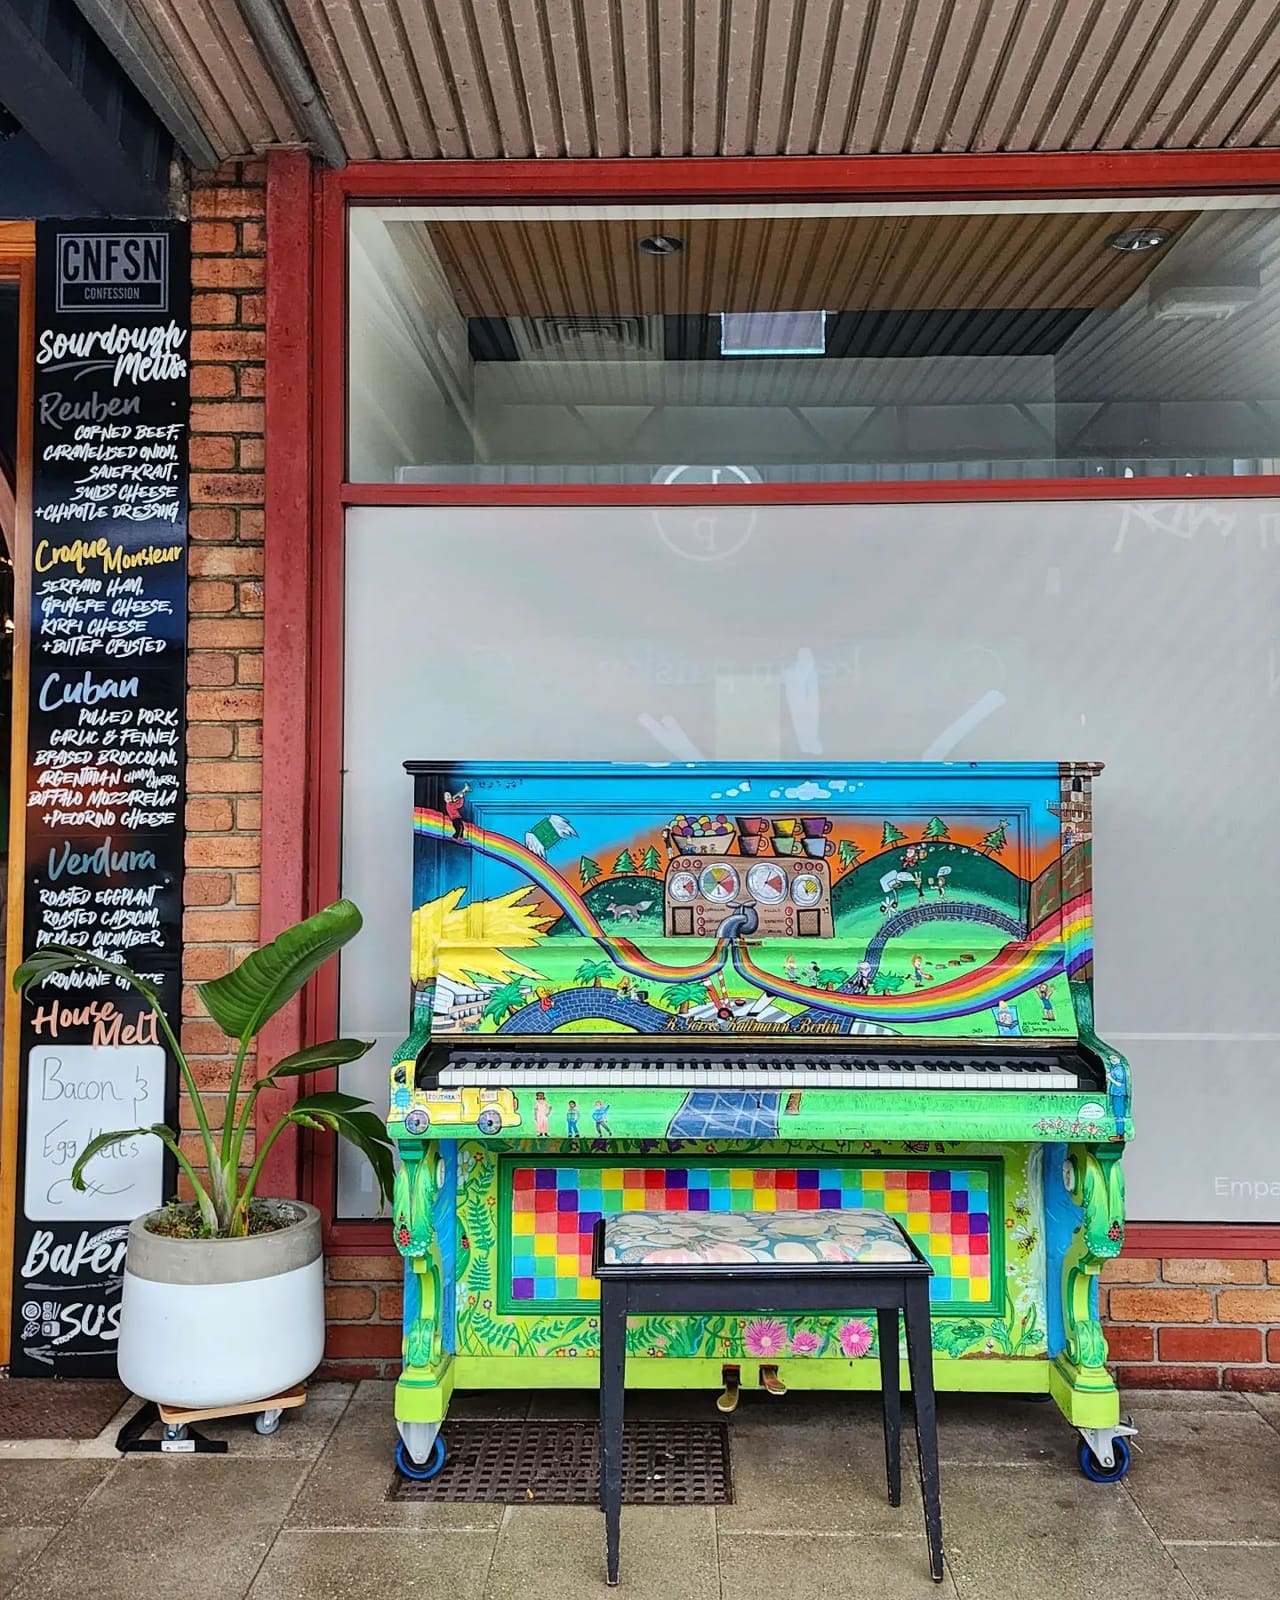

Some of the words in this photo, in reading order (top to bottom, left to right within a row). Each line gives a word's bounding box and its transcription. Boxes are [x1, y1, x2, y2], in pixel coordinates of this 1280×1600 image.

[63, 239, 160, 281] CNFSN
[84, 287, 140, 300] CONFESSION
[36, 320, 187, 364] Sourdough
[113, 349, 187, 387] Melts
[38, 391, 140, 430] Reuben
[74, 424, 132, 442] CORNED
[134, 424, 184, 441] BEEF,
[43, 442, 138, 462] CARAMELISED
[139, 443, 178, 461] ONION,
[74, 462, 179, 484] SAUERKRAUT,
[69, 483, 118, 501] SWISS
[118, 482, 179, 503] CHEESE
[112, 501, 179, 523] DRESSING
[35, 538, 108, 574] Croque
[103, 545, 183, 574] Monsieur
[36, 578, 102, 595] SERRANO
[106, 576, 144, 597] HAM,
[41, 596, 107, 617] GRUYERE
[111, 597, 173, 618] CHEESE,
[87, 617, 148, 638] CHEESE
[42, 634, 103, 656] +BUTTER
[105, 637, 166, 658] CRUSTED
[38, 671, 139, 711] Cuban
[78, 708, 133, 726] PULLED
[50, 729, 99, 746] GARLIC
[102, 729, 117, 746] &
[120, 728, 179, 747] FENNEL
[33, 749, 93, 769] BRAISED
[96, 748, 178, 767] BROCCOLINI,
[27, 788, 83, 807] BUFFALO
[86, 788, 178, 808] MOZZARELLA
[42, 809, 116, 828] +PECORINO
[120, 808, 176, 829] CHEESE
[47, 836, 156, 880] Verdura
[39, 886, 91, 907] ROASTED
[95, 885, 164, 906] EGGPLANT
[42, 908, 97, 930] ROASTED
[100, 908, 160, 929] CAPSICUM,
[36, 929, 90, 948] PICKLED
[42, 969, 112, 990] PROVOLONE
[30, 1000, 118, 1037] House
[92, 1008, 168, 1050] Melt
[42, 1057, 122, 1101] Bacon
[43, 1120, 77, 1165] Egg
